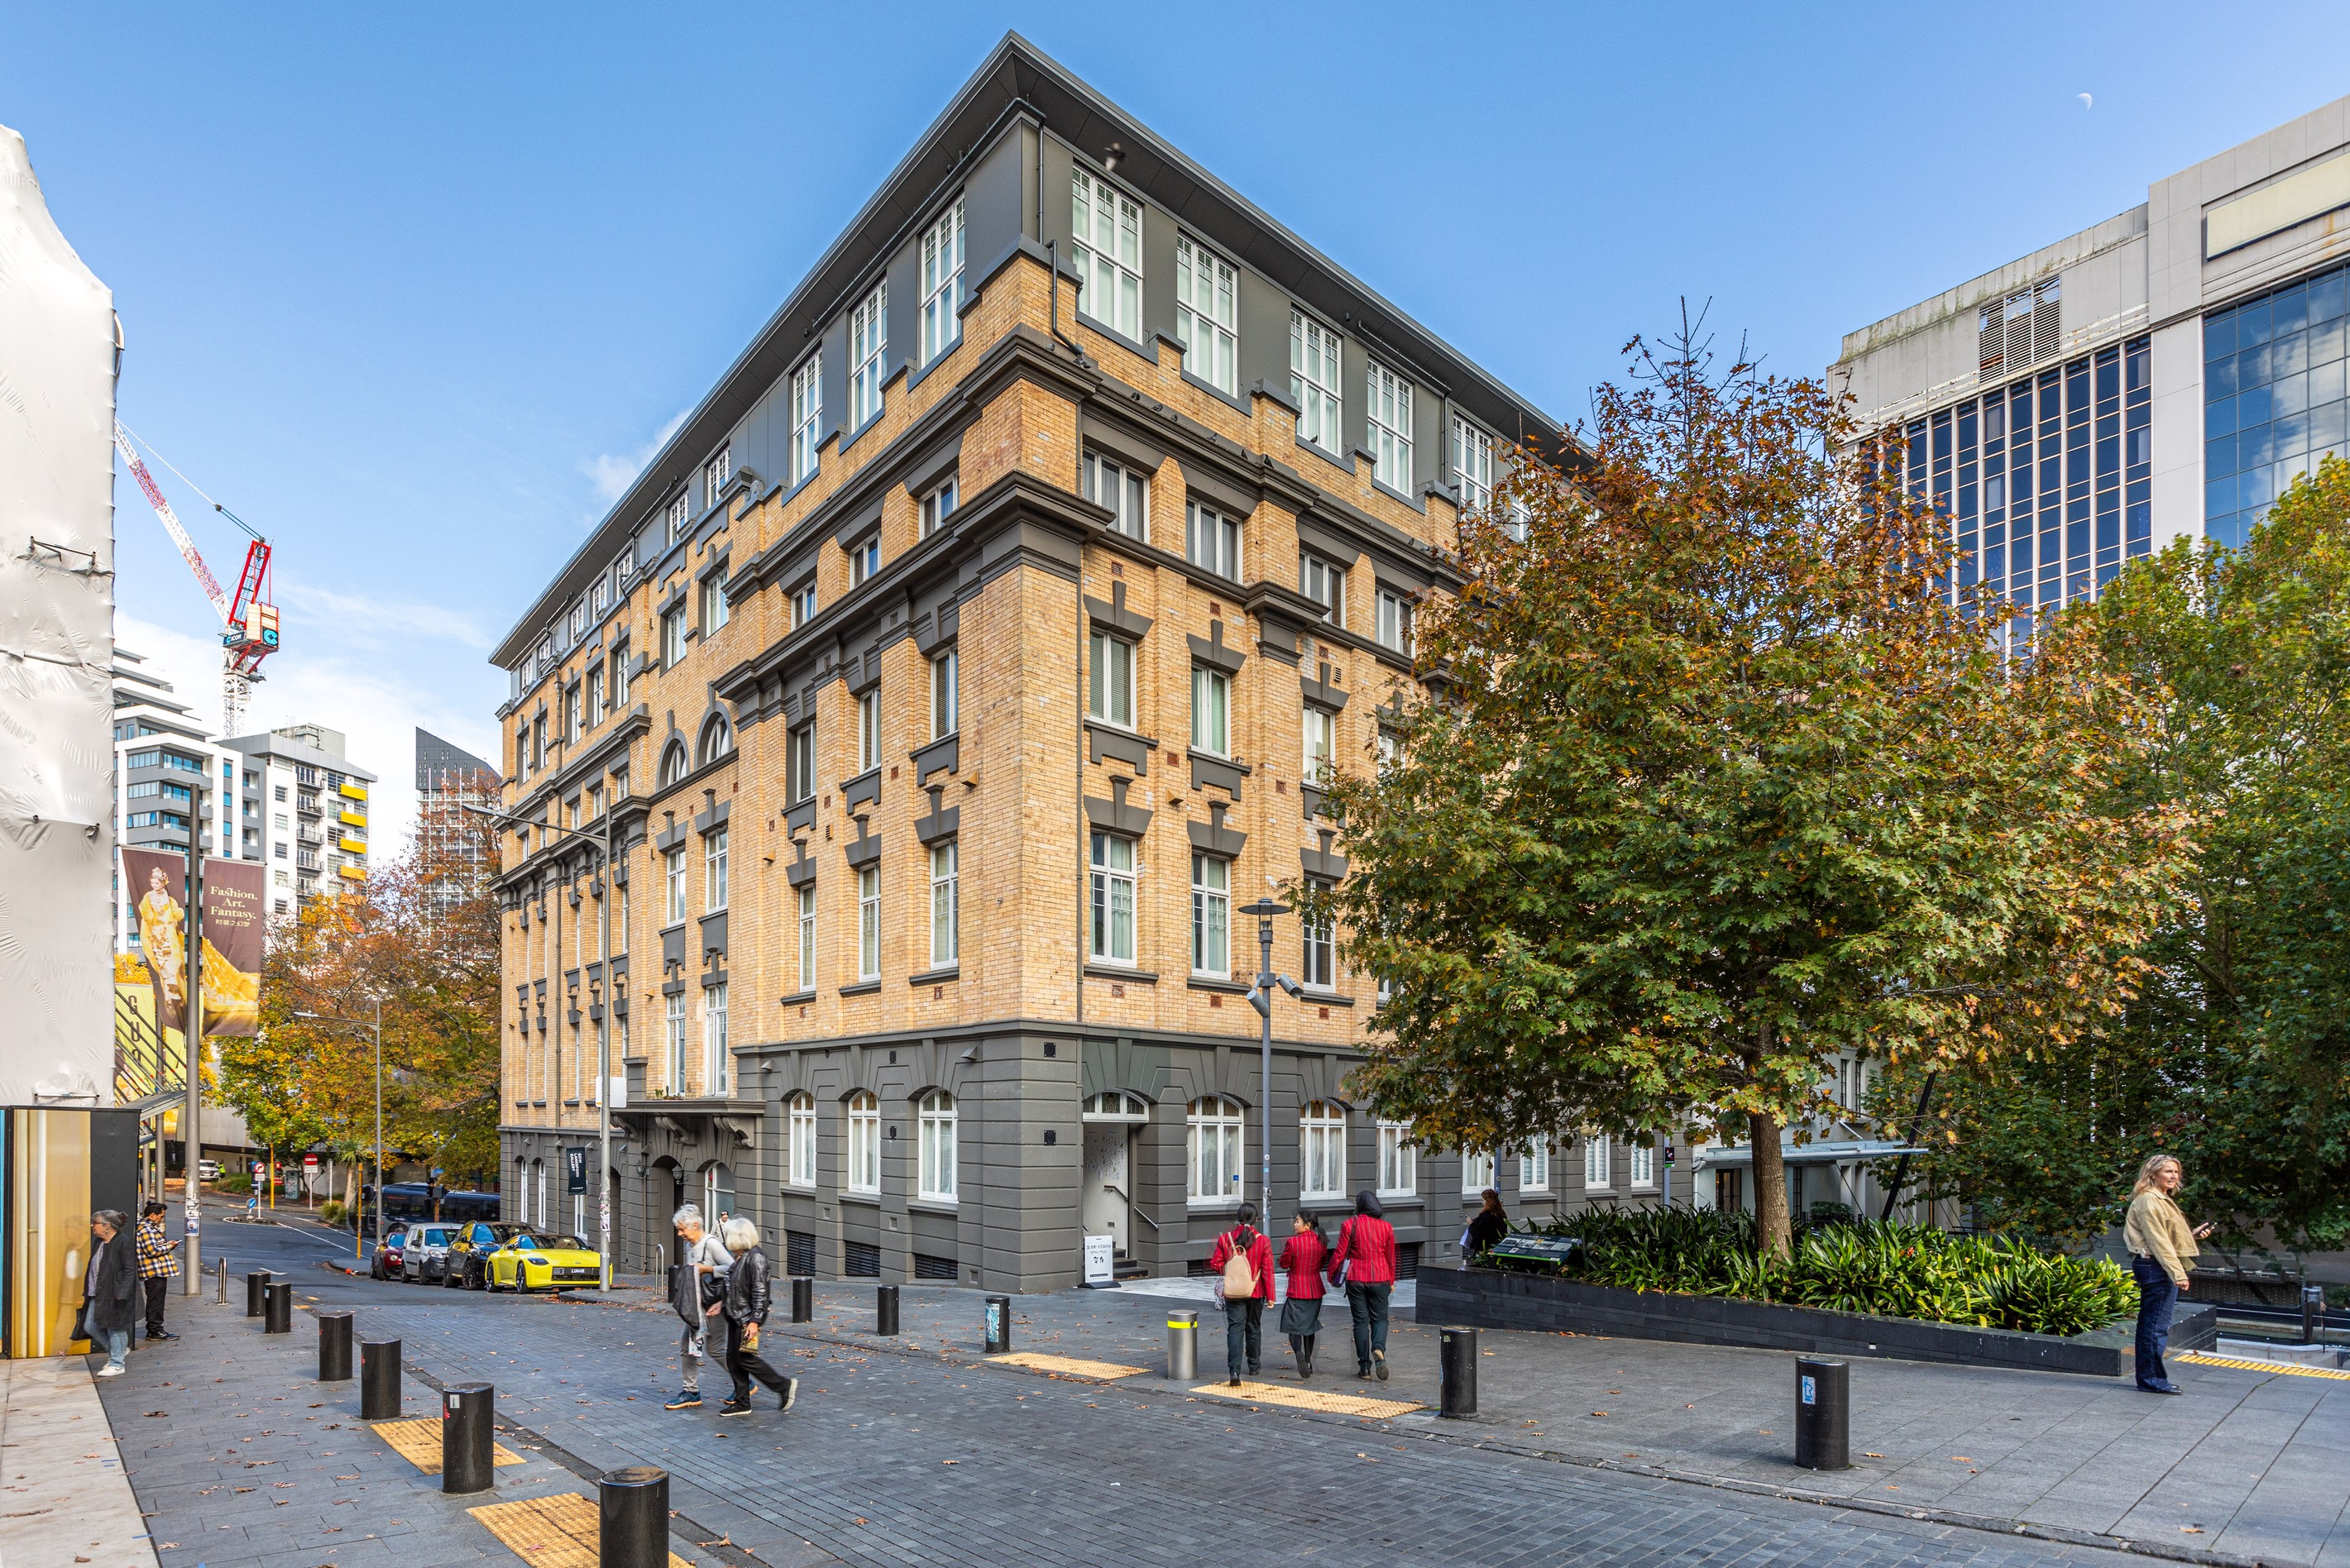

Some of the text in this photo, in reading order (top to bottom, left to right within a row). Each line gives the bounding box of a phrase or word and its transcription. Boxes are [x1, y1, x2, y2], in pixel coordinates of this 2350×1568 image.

[210, 886, 258, 901] Fashion.
[223, 897, 246, 908] Art.
[210, 906, 256, 921] Fantasy.
